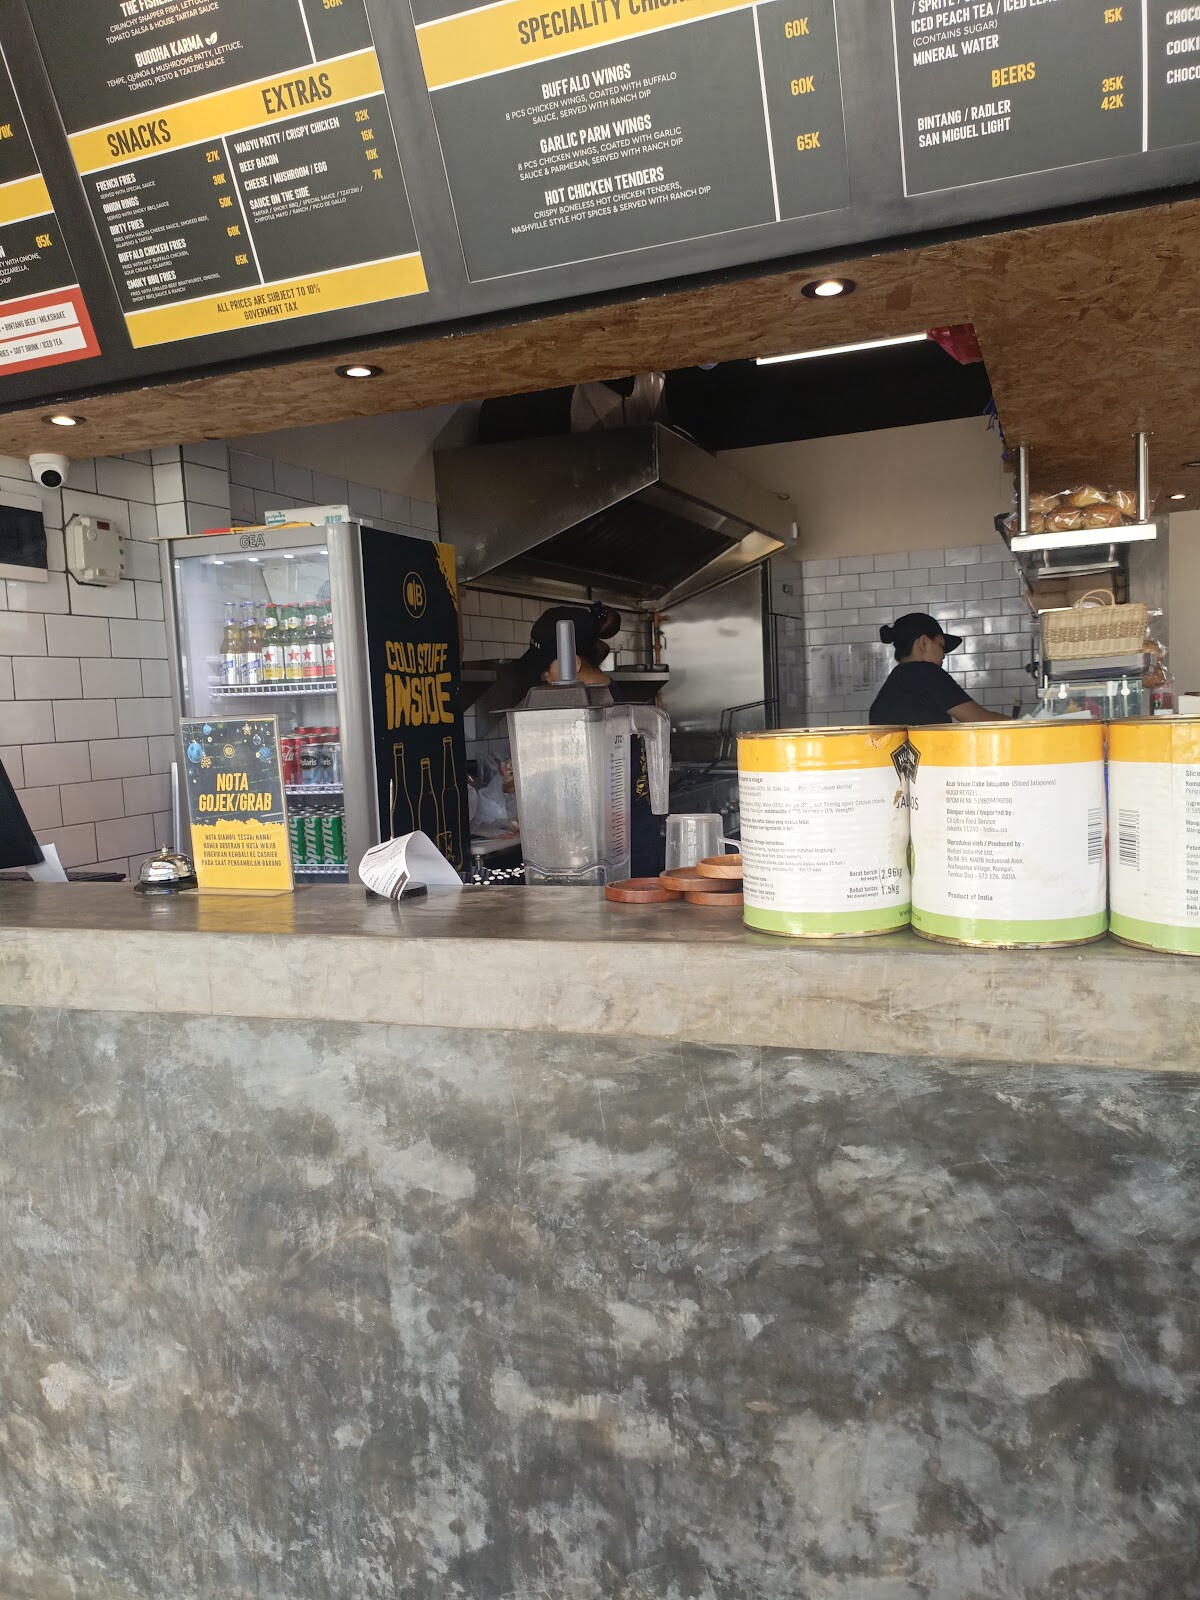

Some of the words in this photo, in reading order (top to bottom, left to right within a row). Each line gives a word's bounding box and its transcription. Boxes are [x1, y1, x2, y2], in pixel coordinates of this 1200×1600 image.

[106, 32, 130, 44] TOMATO
[131, 25, 149, 37] SALSA
[154, 17, 175, 29] HOUSE
[175, 9, 198, 21] TARTAR
[199, 2, 219, 15] SAUCE
[518, 0, 621, 45] SPECIALITY
[785, 16, 809, 39] 60K
[911, 16, 933, 34] ICED
[936, 7, 970, 28] PEACH
[972, 3, 994, 20] TEA
[1104, 7, 1122, 24] 15K
[913, 27, 961, 48] (CONTAINS
[964, 19, 998, 35] SUGAR)
[107, 76, 128, 88] TEMPE,
[128, 69, 151, 83] QUINOA
[156, 56, 194, 73] MUSHROOMS
[194, 50, 214, 60] PATTY,
[215, 41, 243, 55] LETTUCE,
[134, 44, 171, 67] BUDDHA
[169, 34, 204, 53] KARMA
[913, 44, 958, 66] MINERAL
[961, 34, 999, 56] WATER
[128, 79, 155, 92] TOMATO,
[155, 72, 174, 83] PESTO
[179, 62, 205, 75] TZATZIKI
[205, 56, 225, 68] SAUCE
[542, 73, 591, 100] BUFFALO
[591, 63, 632, 86] WINGS
[791, 75, 815, 96] 60K
[991, 61, 1036, 88] BEERS
[1102, 75, 1123, 93] 35K
[261, 72, 333, 115] EXTRAS
[512, 108, 526, 119] PCS
[526, 101, 559, 115] CHICKEN
[560, 94, 588, 107] WINGS,
[589, 87, 620, 100] COATED
[620, 81, 641, 92] WITH
[642, 72, 677, 87] BUFFALO
[532, 113, 559, 125] SAUCE,
[560, 105, 588, 118] SERVED
[588, 100, 609, 111] WITH
[610, 93, 638, 106] RANCH
[638, 89, 652, 100] DIP
[1101, 94, 1124, 110] 42K
[354, 109, 369, 122] 32K
[917, 110, 962, 131] BINTANG
[970, 99, 1011, 120] RADLER
[107, 118, 172, 157] SNACKS
[234, 138, 260, 154] WAGYU
[259, 131, 281, 148] PATTY
[285, 124, 309, 140] CRISPY
[310, 116, 340, 133] CHICKEN
[360, 128, 374, 142] 16K
[539, 131, 579, 154] GARLIC
[579, 123, 611, 146] PARM
[612, 114, 652, 137] WINGS
[796, 131, 821, 152] 65K
[918, 131, 940, 148] SAN
[942, 124, 978, 144] MIGUEL
[981, 117, 1011, 135] LIGHT
[206, 150, 220, 163] 27K
[365, 148, 379, 161] 10K
[520, 169, 544, 181] SAUCE
[550, 158, 591, 174] PARMESAN,
[592, 151, 620, 165] SERVED
[620, 147, 642, 157] WITH
[642, 140, 670, 153] RANCH
[670, 137, 684, 148] DIP
[524, 159, 538, 169] PCS
[539, 151, 571, 165] CHICKEN
[571, 146, 600, 157] WINGS,
[600, 139, 631, 152] COATED
[631, 134, 653, 144] WITH
[653, 127, 682, 139] GARLIC
[239, 160, 256, 173] BEEF
[256, 153, 279, 169] BACON
[244, 176, 269, 191] CHEESE
[273, 165, 310, 183] MUSHROOM
[314, 161, 328, 173] EGG
[372, 168, 383, 180] 7K
[96, 180, 120, 192] FRENCH
[118, 173, 137, 187] FRIES
[544, 187, 566, 206] HOT
[567, 178, 613, 201] CHICKEN
[614, 166, 665, 191] TENDERS
[102, 201, 122, 214] ONION
[120, 196, 139, 209] RINGS
[249, 196, 271, 210] SAUCE
[271, 194, 280, 205] ON
[280, 190, 295, 202] THE
[294, 186, 310, 199] SIDE
[511, 219, 549, 235] NASHVILLE
[549, 216, 570, 227] STYLE
[571, 212, 586, 222] HOT
[587, 206, 612, 218] SPICES
[619, 200, 648, 212] SERVED
[648, 195, 669, 205] WITH
[670, 188, 698, 201] RANCH
[698, 185, 712, 195] DIP
[533, 207, 558, 220] CRISPY
[558, 200, 595, 214] BONELESS
[595, 196, 612, 206] HOT
[613, 189, 646, 202] CHICKEN
[647, 181, 683, 195] TENDERS,
[35, 234, 52, 249] 85K
[109, 224, 127, 236] DIRTY
[126, 219, 145, 232] FRIES
[118, 248, 145, 263] BUFFALO
[144, 242, 169, 256] CHICKEN
[168, 238, 187, 251] FRIES
[126, 277, 148, 290] SMOKY
[160, 270, 176, 282] FRIES
[217, 303, 229, 313] ALL
[230, 298, 252, 311] PRICES
[253, 295, 267, 305] ARE
[267, 288, 295, 303] SUBJECT
[297, 287, 306, 296] TO
[306, 283, 321, 295] 10%
[244, 304, 283, 320] GOVERMENT
[284, 301, 299, 313] TAX
[13, 347, 24, 355] SOFT
[24, 343, 39, 352] DRINK
[42, 340, 54, 348] ICED
[53, 338, 64, 346] TEA
[240, 534, 266, 548] GEA
[385, 641, 416, 674] COLD
[417, 642, 448, 674] STUFF
[385, 672, 454, 730] INSIDE
[216, 772, 249, 792] NOTA
[199, 793, 272, 812] GOJEK/GRAB
